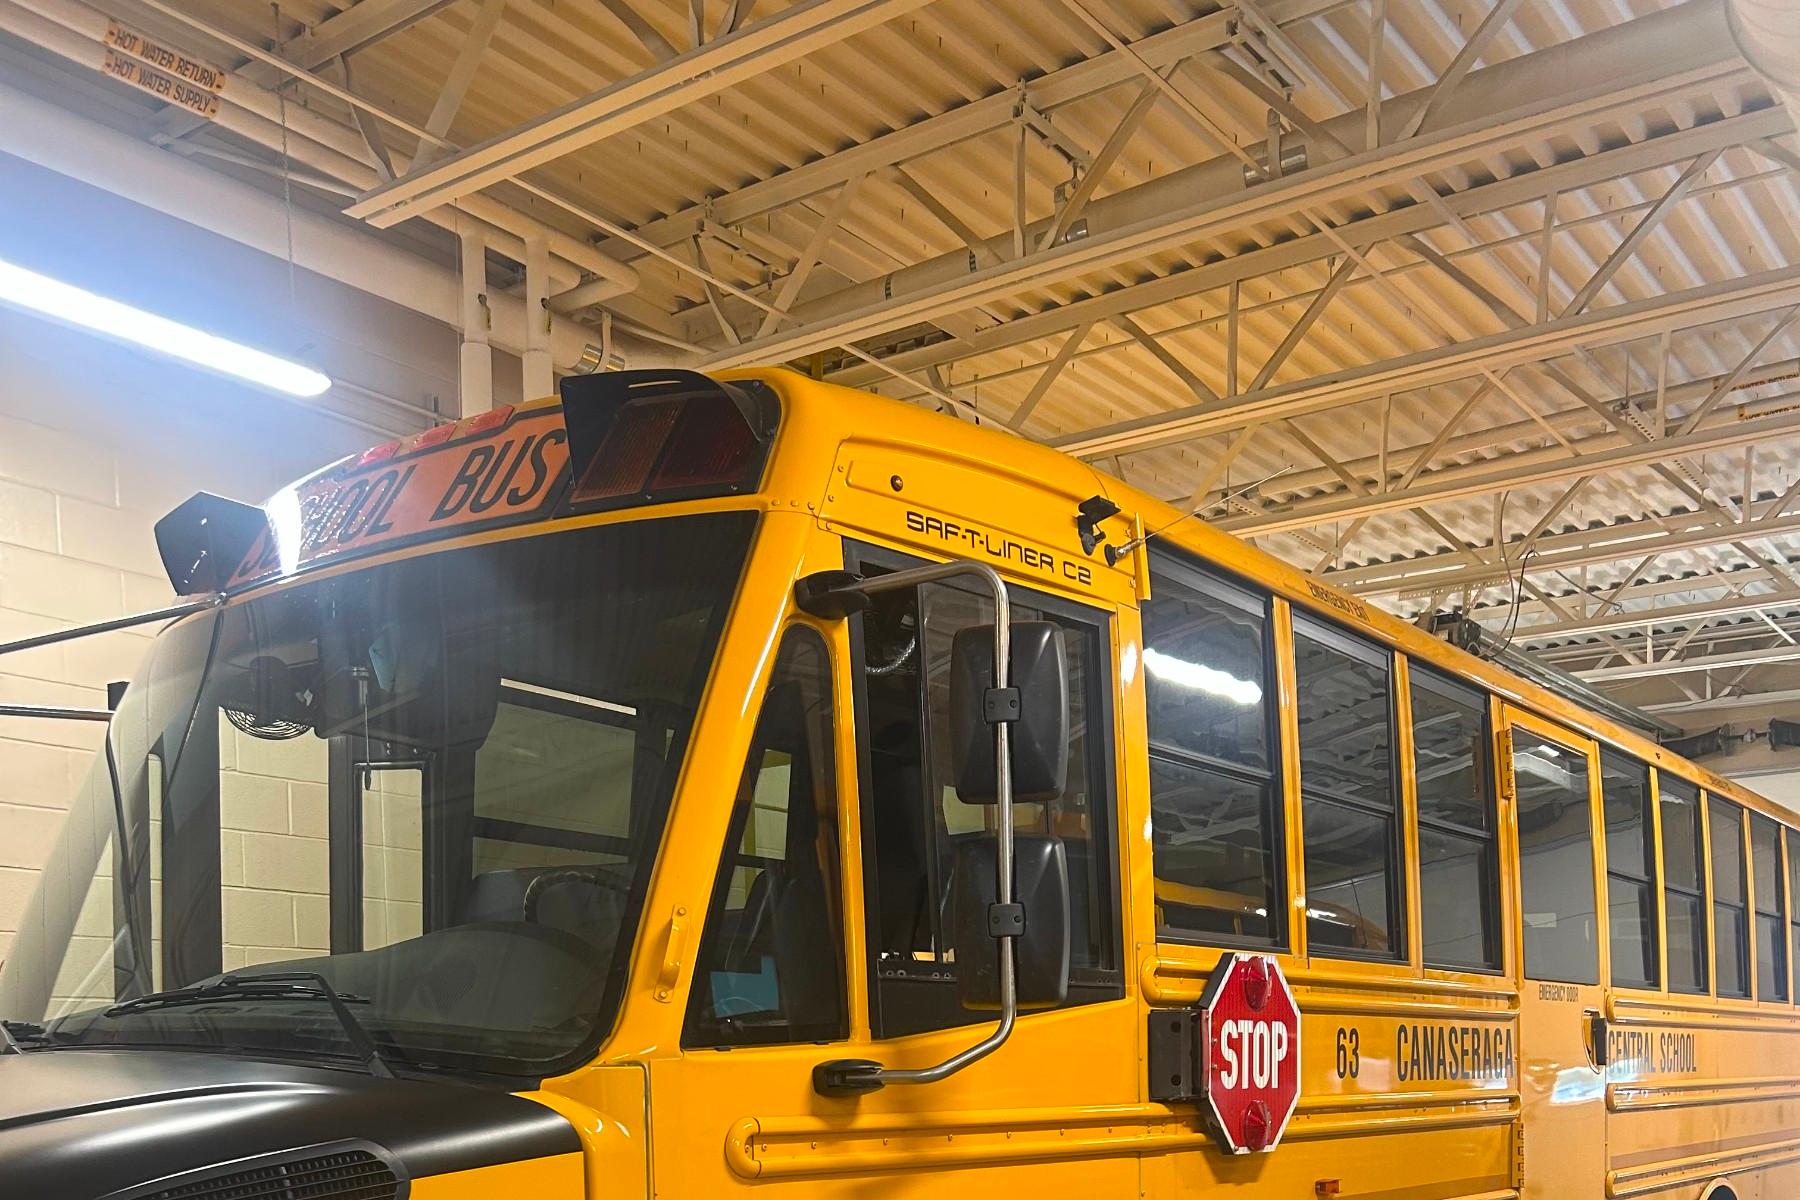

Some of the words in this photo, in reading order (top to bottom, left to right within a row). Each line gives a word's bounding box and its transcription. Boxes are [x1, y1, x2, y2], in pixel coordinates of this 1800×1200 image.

[112, 56, 136, 80] HOT
[138, 69, 172, 98] WATER
[173, 84, 211, 113] SUPPLY
[115, 28, 138, 52] HOT
[140, 39, 175, 70] WATER
[176, 57, 216, 88] RETURN
[429, 428, 567, 521] BUS
[906, 511, 1055, 573] SAF-T-LINER
[1063, 560, 1092, 586] C2
[1539, 983, 1566, 1001] EMERGENCY
[1220, 1019, 1288, 1090] STOP
[1336, 1027, 1360, 1079] 63
[1397, 1024, 1514, 1082] CANASERAGA
[1608, 1030, 1656, 1073] CENTRAL
[1660, 1032, 1697, 1073] SCHOOL
